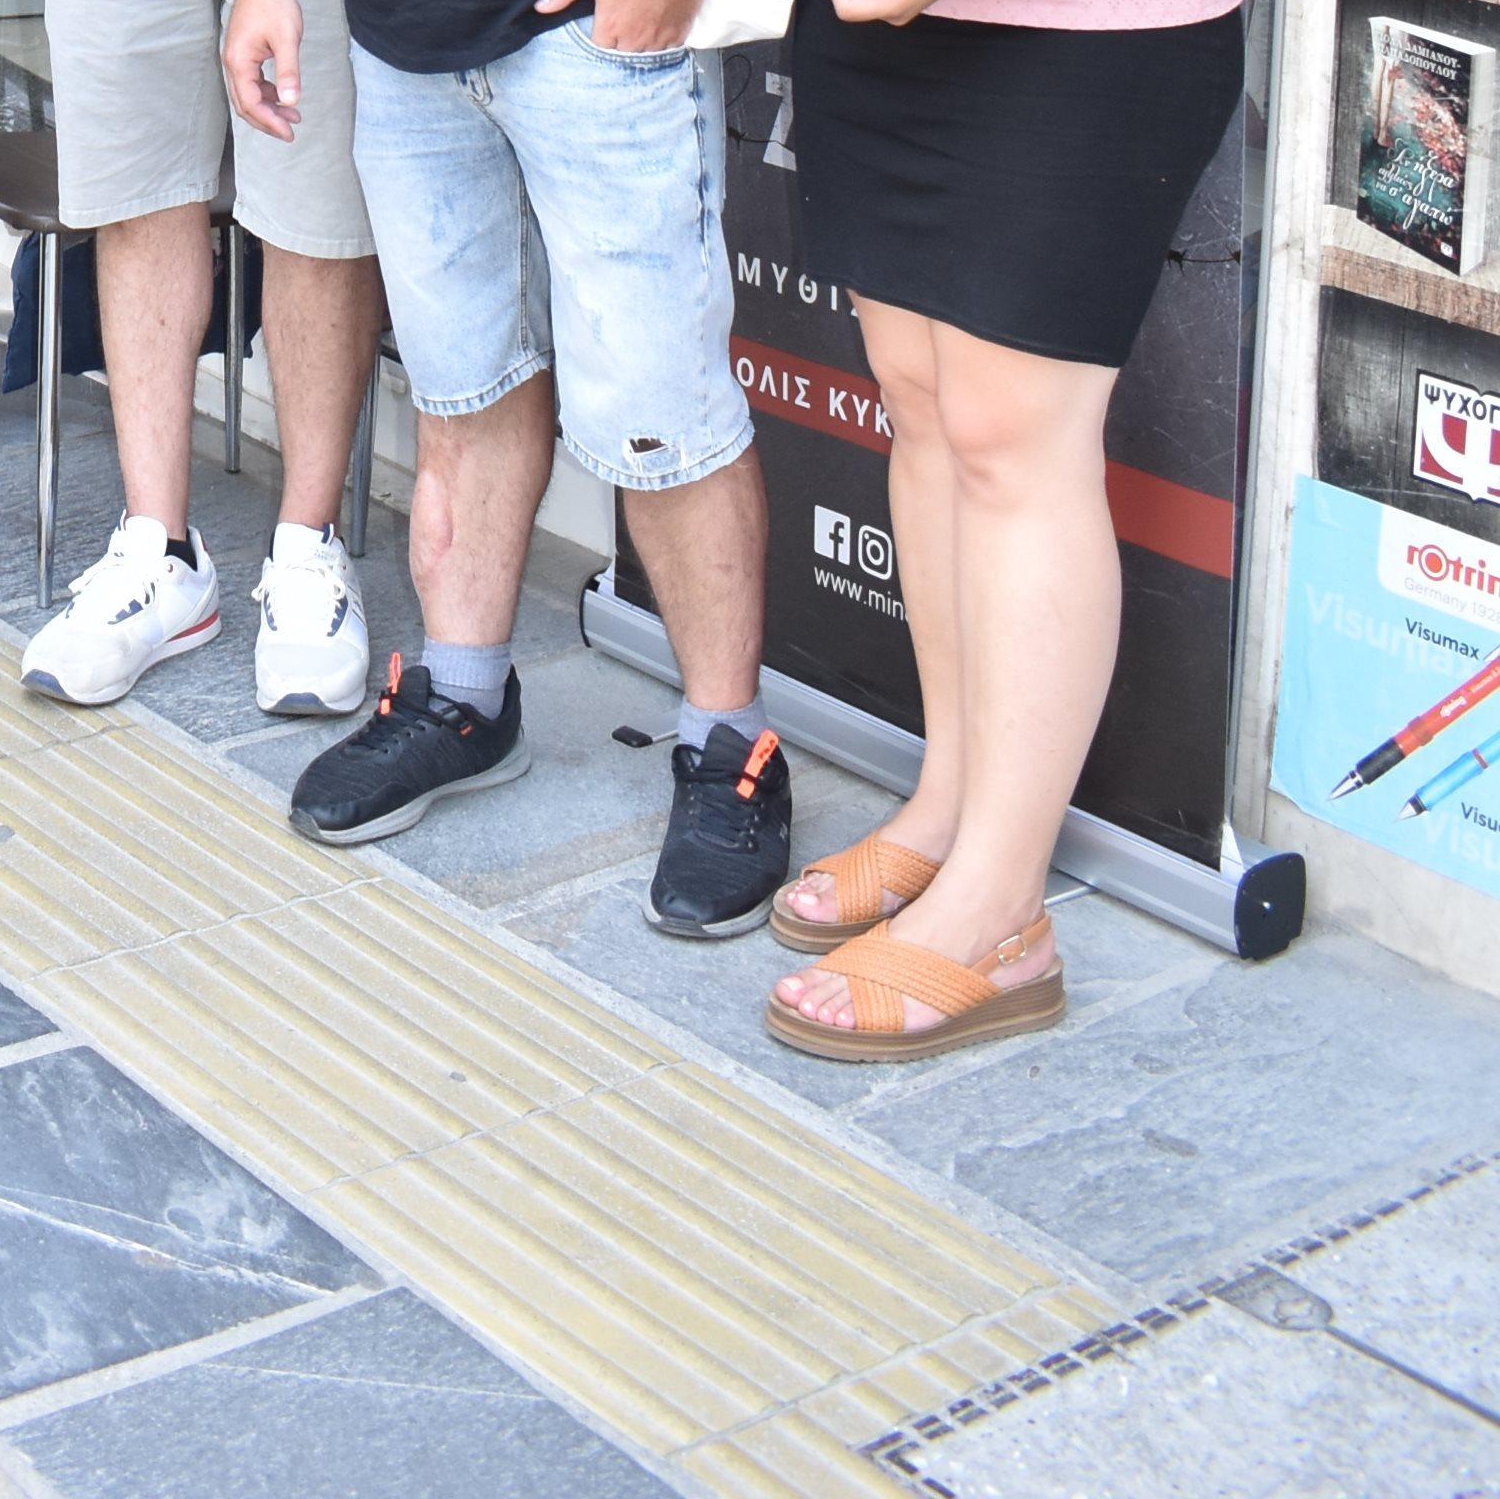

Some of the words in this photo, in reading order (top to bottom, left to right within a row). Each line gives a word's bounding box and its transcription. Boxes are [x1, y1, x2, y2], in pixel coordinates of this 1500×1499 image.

[813, 565, 910, 623] www.min
[1404, 576, 1467, 614] Germany
[1405, 617, 1480, 660] Visumax
